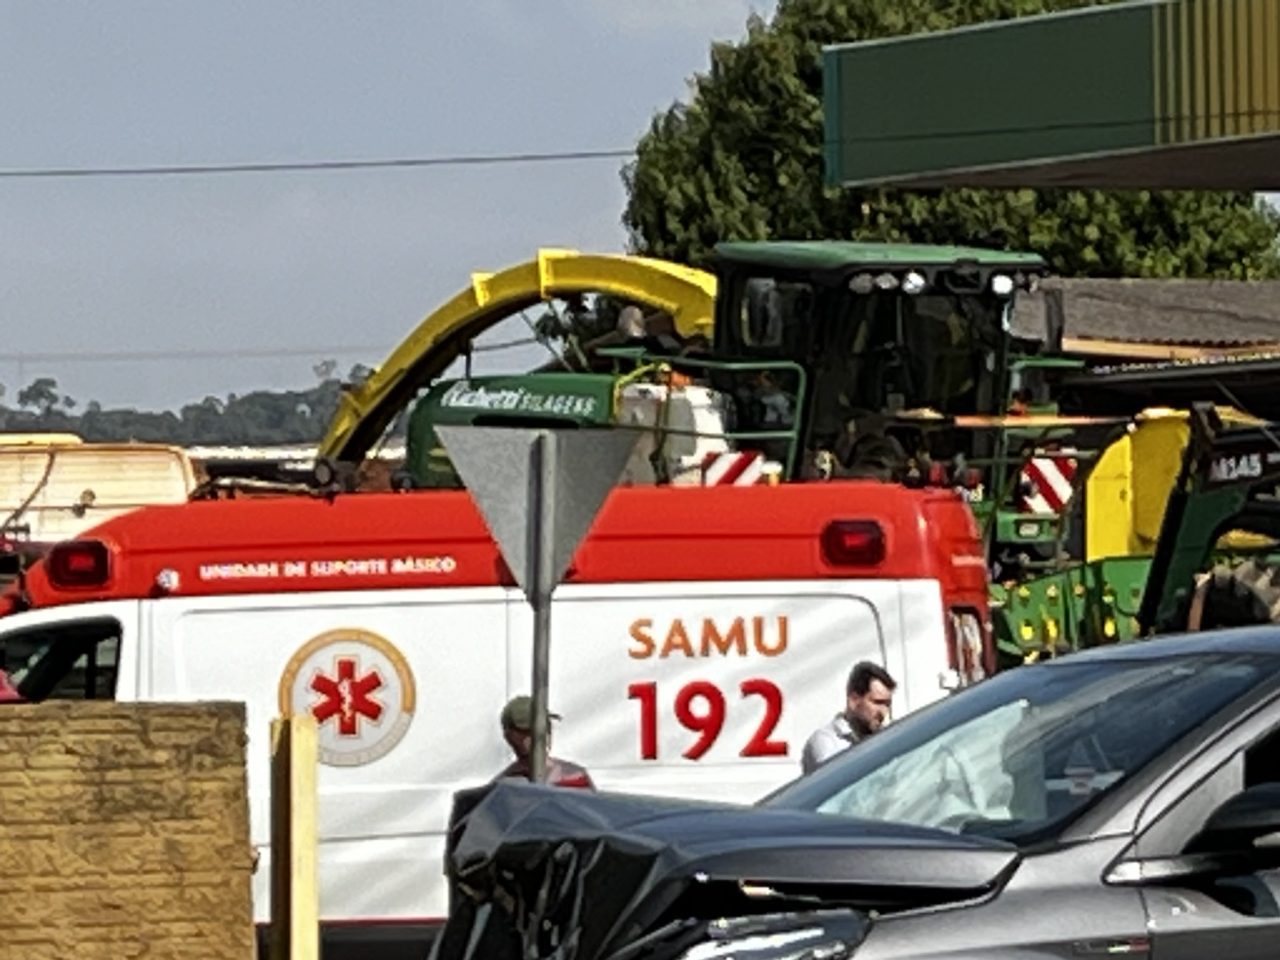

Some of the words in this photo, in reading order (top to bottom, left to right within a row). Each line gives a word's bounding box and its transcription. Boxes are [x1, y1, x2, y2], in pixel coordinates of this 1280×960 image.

[200, 562, 278, 580] UNIDADE
[284, 560, 306, 578] DE
[310, 558, 387, 577] SUPORTE
[628, 616, 788, 660] SAMU
[628, 678, 789, 761] 192
